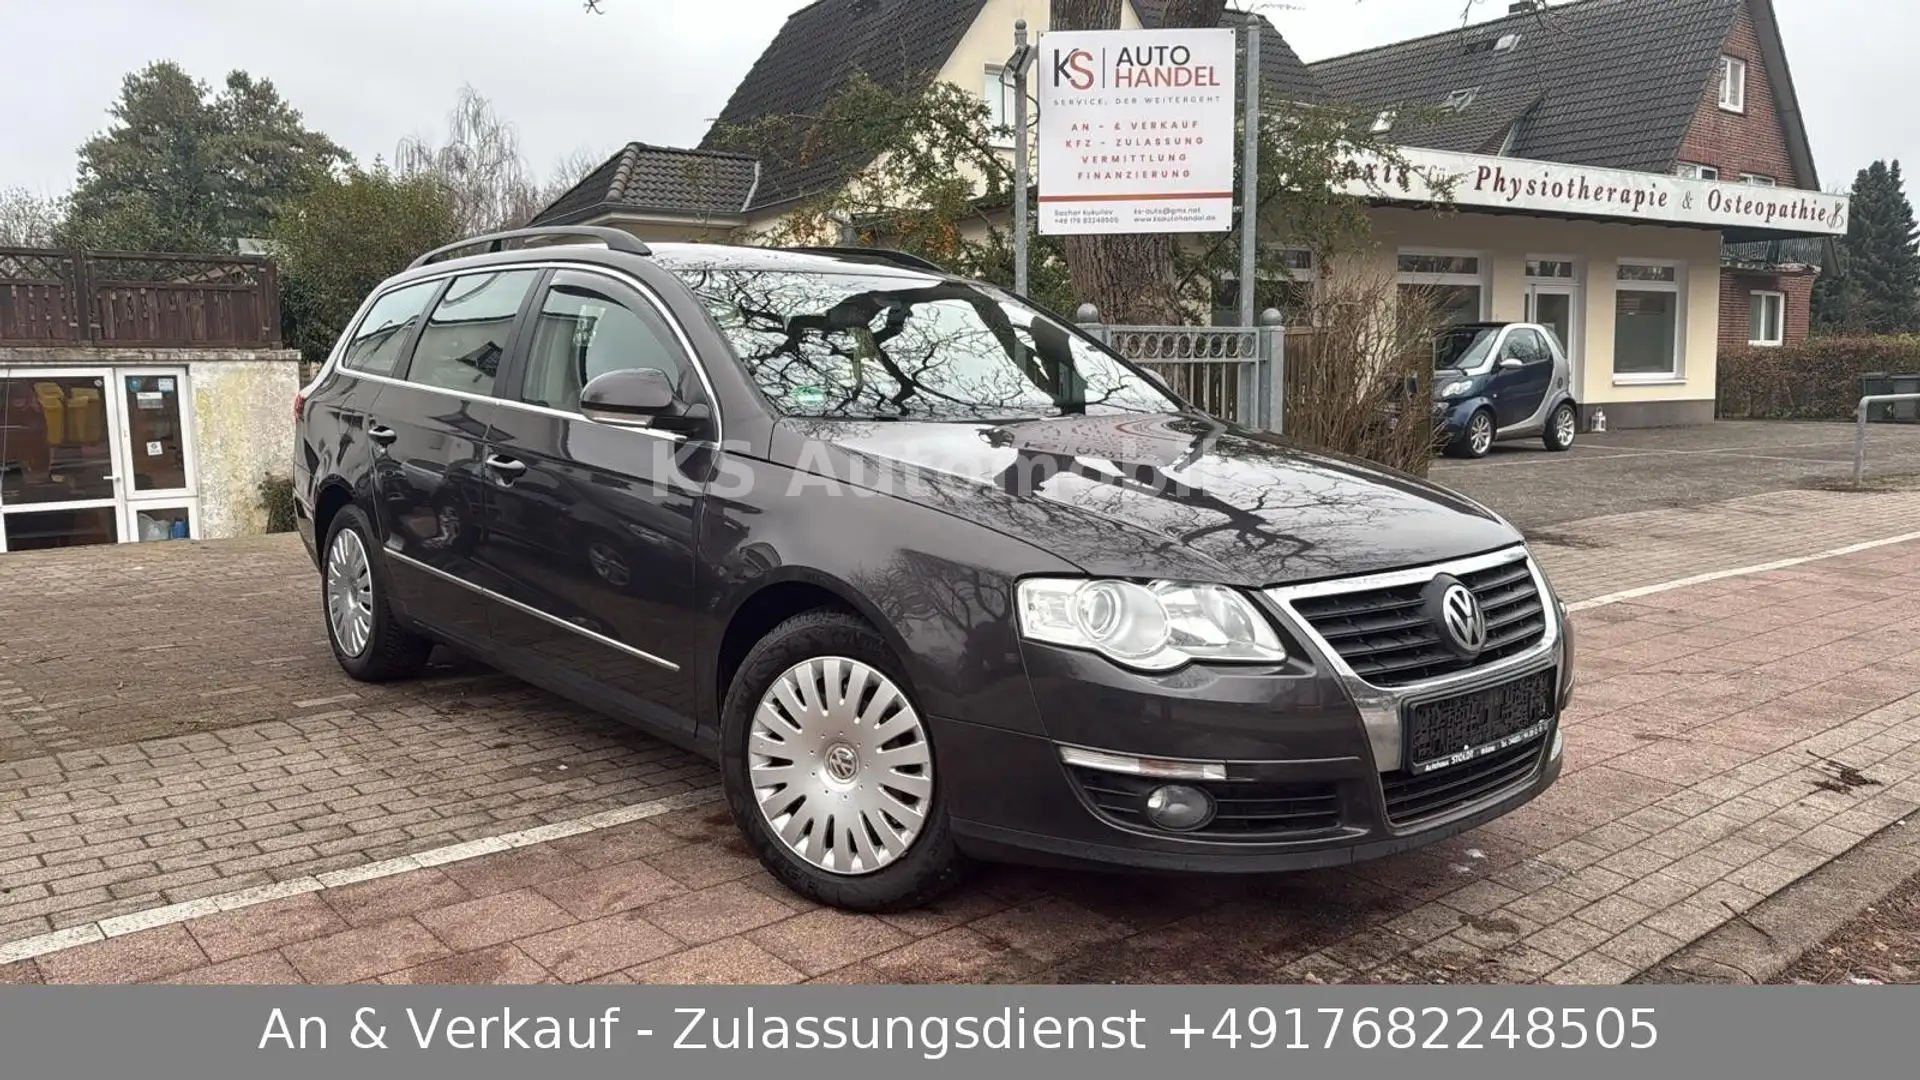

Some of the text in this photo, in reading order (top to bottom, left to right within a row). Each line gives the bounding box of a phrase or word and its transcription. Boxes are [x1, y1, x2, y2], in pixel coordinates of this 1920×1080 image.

[1116, 45, 1191, 67] AUTO
[1054, 48, 1094, 90] KS
[1115, 66, 1220, 88] HANDEL
[1053, 97, 1108, 106] SERVICE,
[1115, 97, 1137, 105] DER
[1071, 123, 1090, 132] AN
[1114, 122, 1121, 131] &
[1131, 120, 1199, 131] VERKAUF
[1066, 139, 1092, 148] KFZ
[1115, 136, 1204, 147] ZULASSUNG
[1082, 153, 1187, 164] VERMITTLUNG
[1077, 170, 1190, 180] FINANZIERUNG
[1474, 165, 1668, 213] Physiotherapie
[1681, 191, 1694, 209] &
[1707, 188, 1827, 225] Osteopathie
